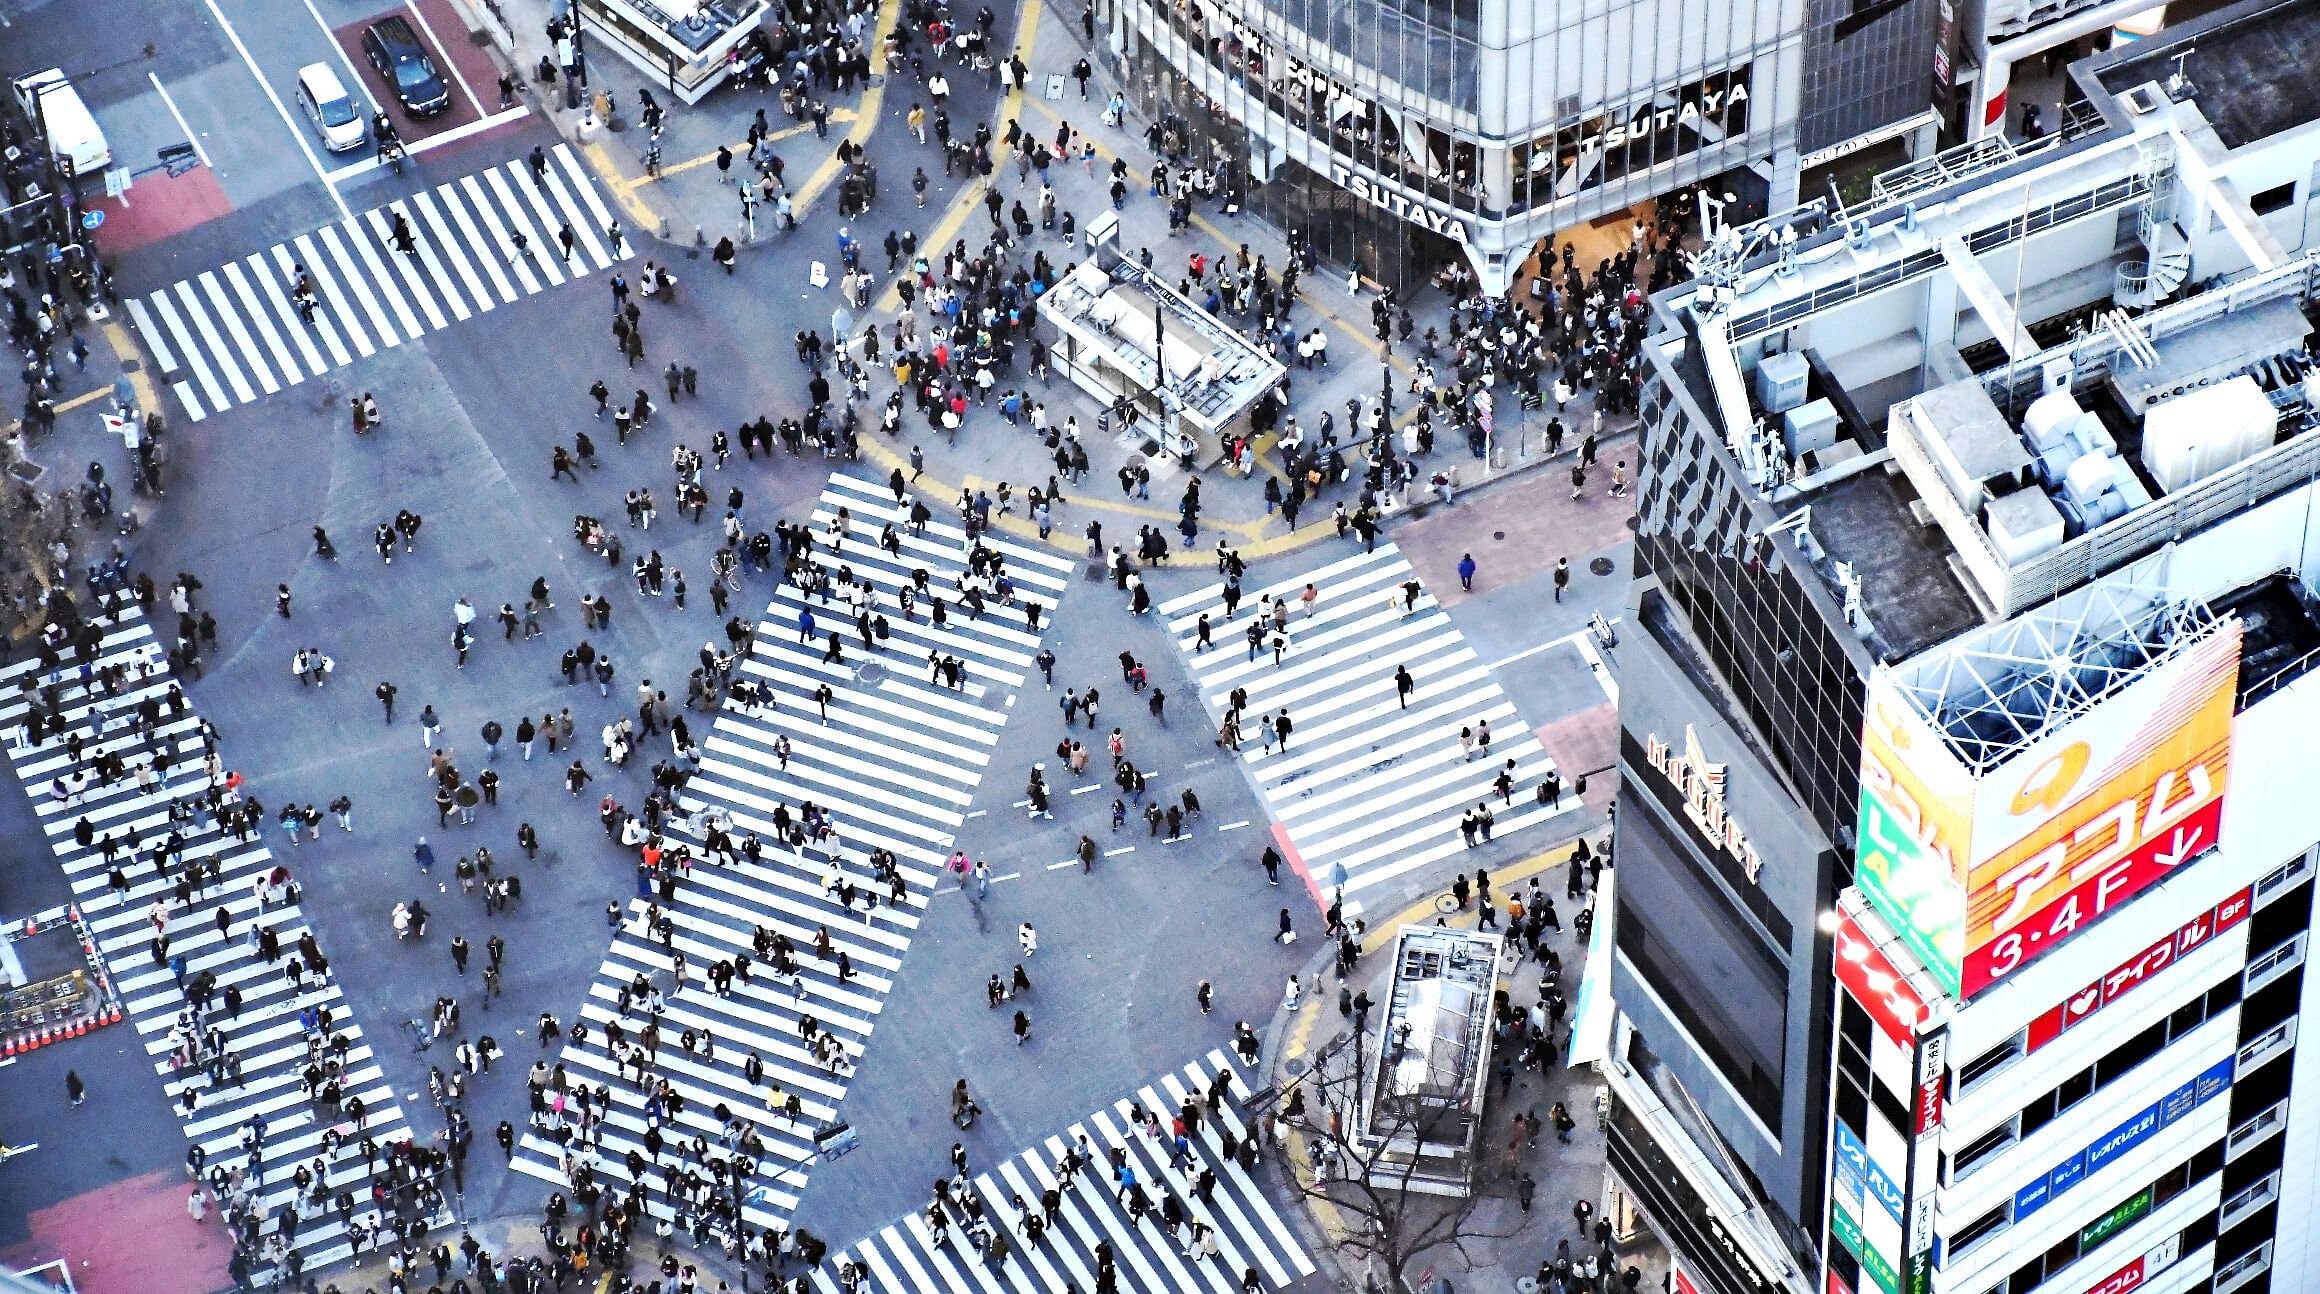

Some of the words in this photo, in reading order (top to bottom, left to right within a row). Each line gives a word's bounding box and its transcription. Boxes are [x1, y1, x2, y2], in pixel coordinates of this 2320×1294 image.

[1582, 84, 1748, 155] TSUTAYA
[1333, 163, 1468, 245] TSUTAYA
[1993, 762, 2211, 931] アコム
[2107, 924, 2207, 997] アイフル
[2221, 899, 2246, 921] 8F
[1923, 1089, 1938, 1130] アイフル
[2092, 1113, 2155, 1161] レオパレス21
